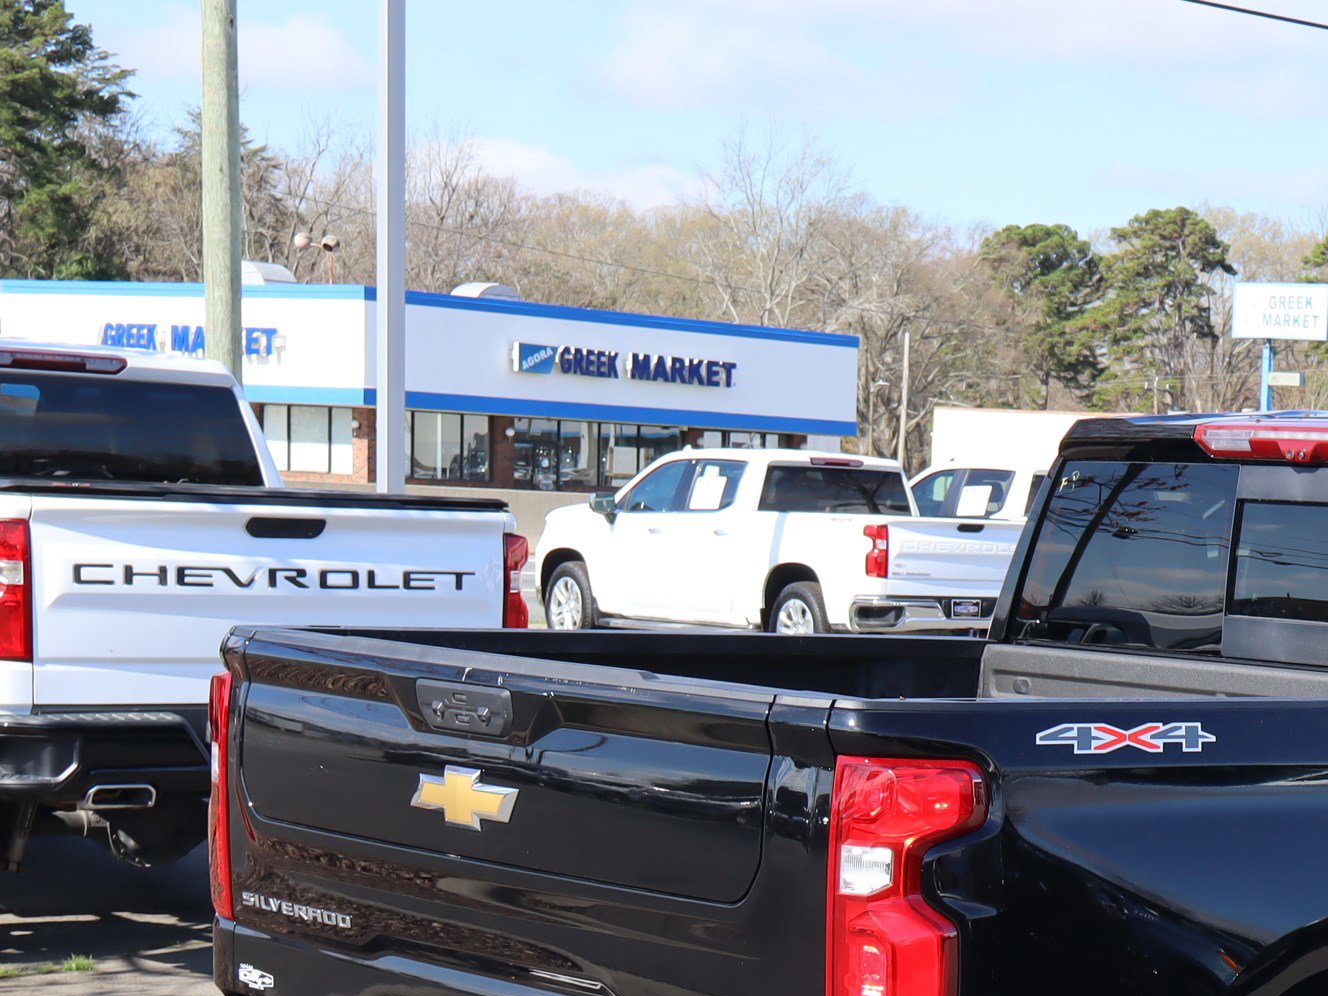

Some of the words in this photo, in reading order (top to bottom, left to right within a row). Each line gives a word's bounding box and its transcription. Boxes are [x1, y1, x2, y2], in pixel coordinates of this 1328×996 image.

[1269, 295, 1313, 310] GREEK
[1262, 313, 1319, 329] MARKET
[102, 322, 157, 351] GREEK
[170, 324, 279, 355] MAET
[522, 346, 553, 370] AGORA
[559, 346, 619, 378] GREEK
[630, 351, 737, 388] MARKET
[72, 563, 476, 591] CHEVROLET
[242, 891, 353, 929] SILVERADO
